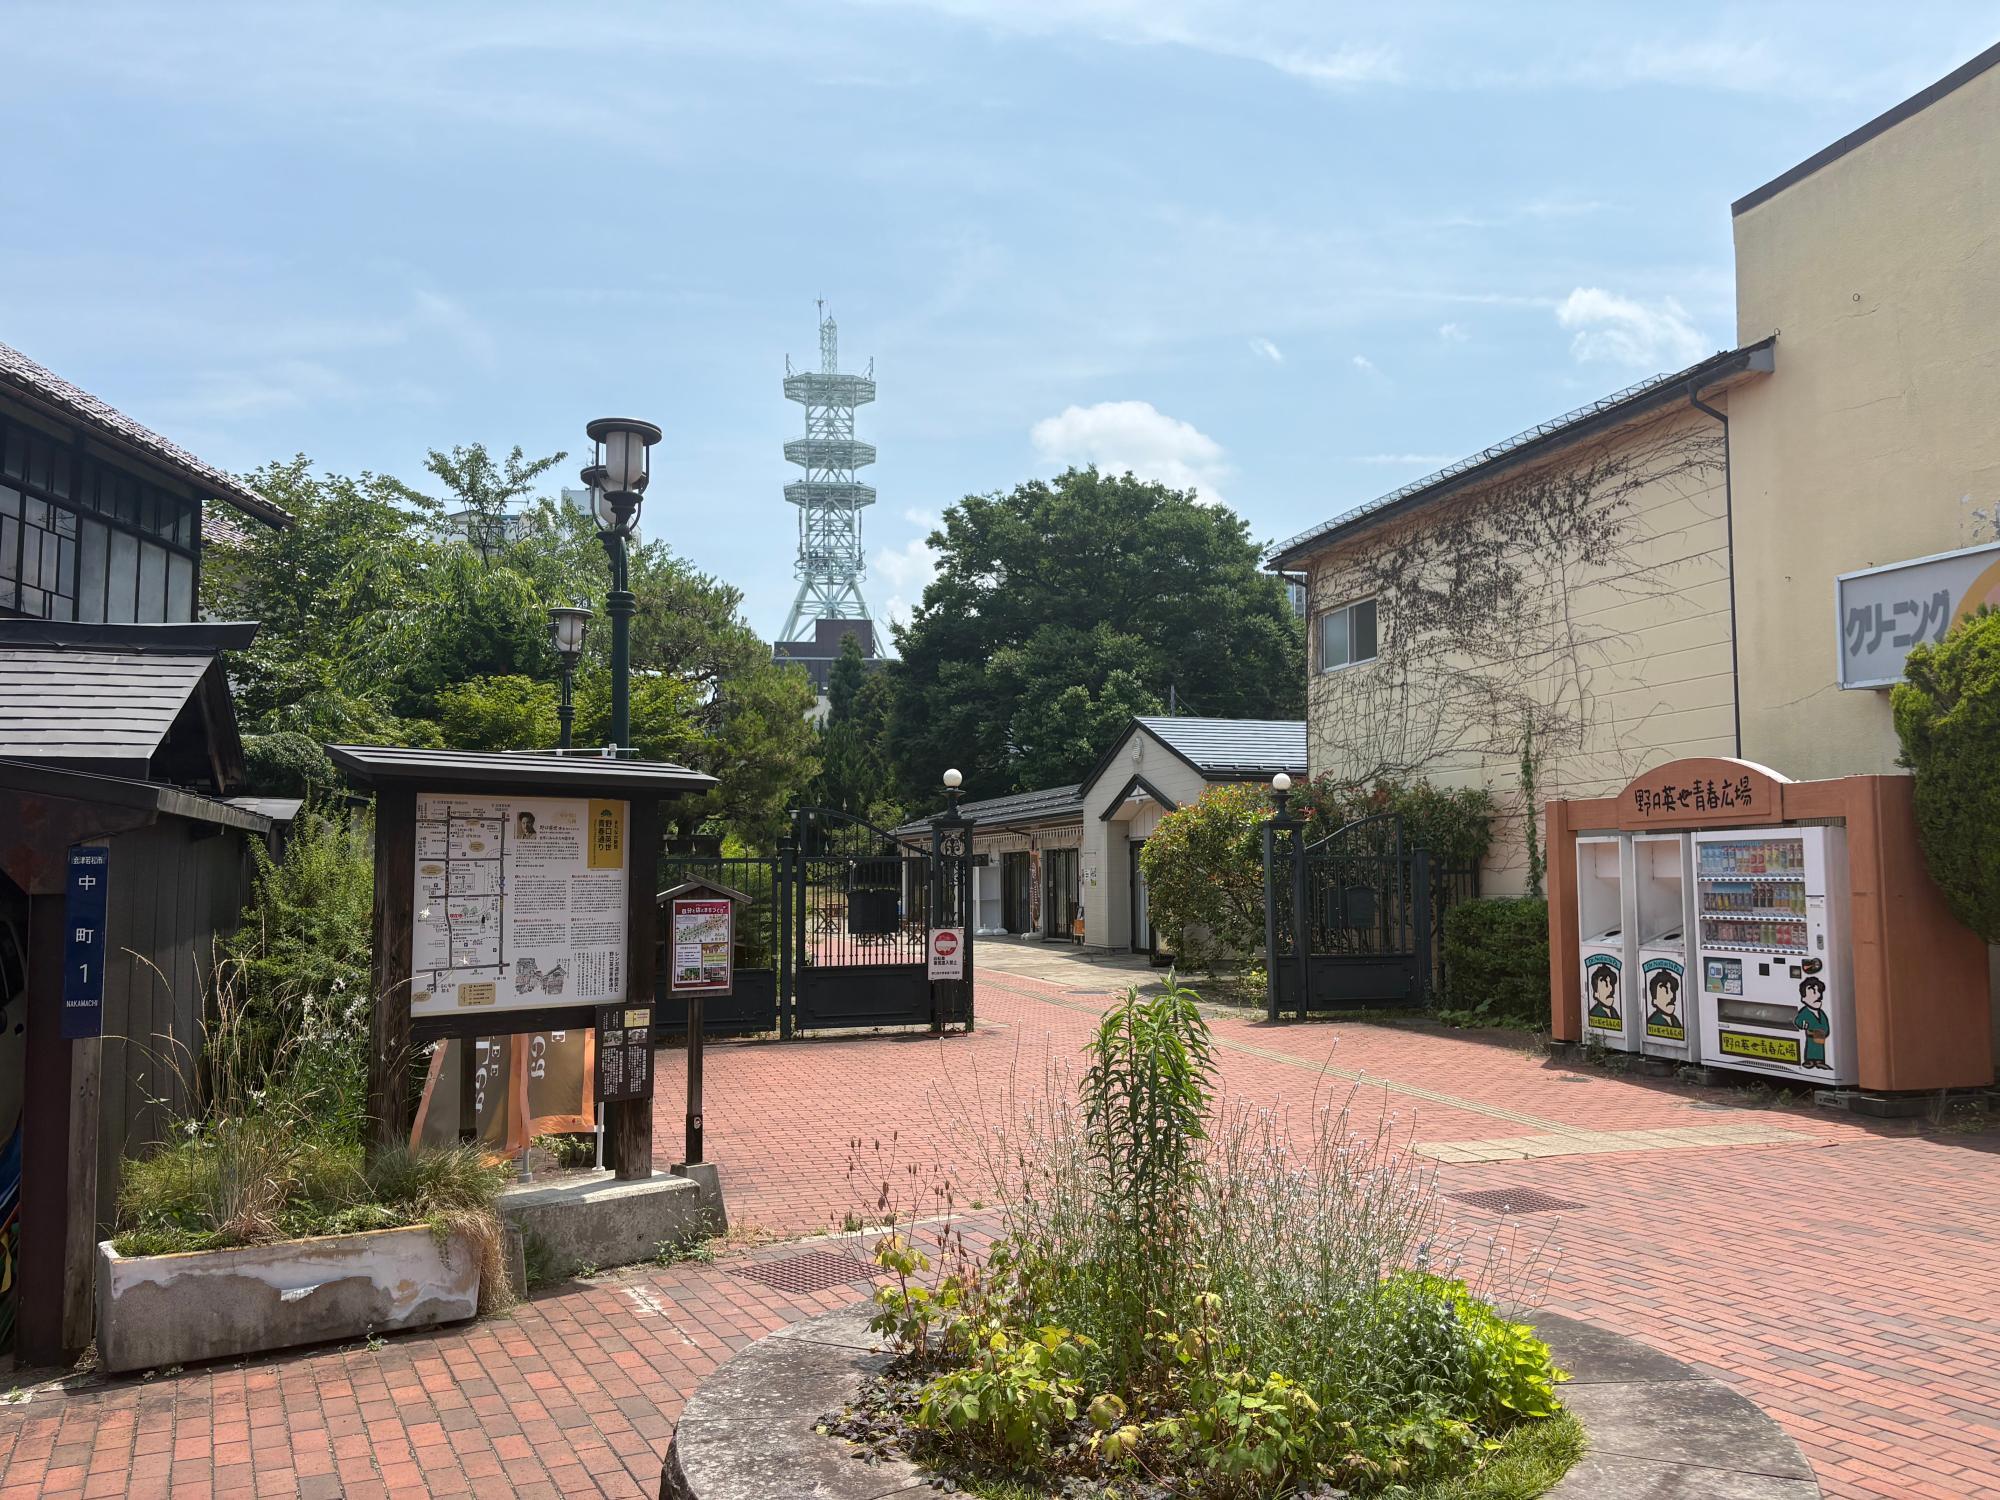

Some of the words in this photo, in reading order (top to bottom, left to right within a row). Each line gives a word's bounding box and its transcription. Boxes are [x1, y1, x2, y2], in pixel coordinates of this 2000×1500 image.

[1846, 589, 1950, 657] クリーニング
[1635, 776, 1752, 816] 野口英世青春広場
[73, 856, 103, 865] 会津若松市
[66, 999, 98, 1008] NAKAMACHI
[1723, 1036, 1796, 1057] 野口英世青春広場
